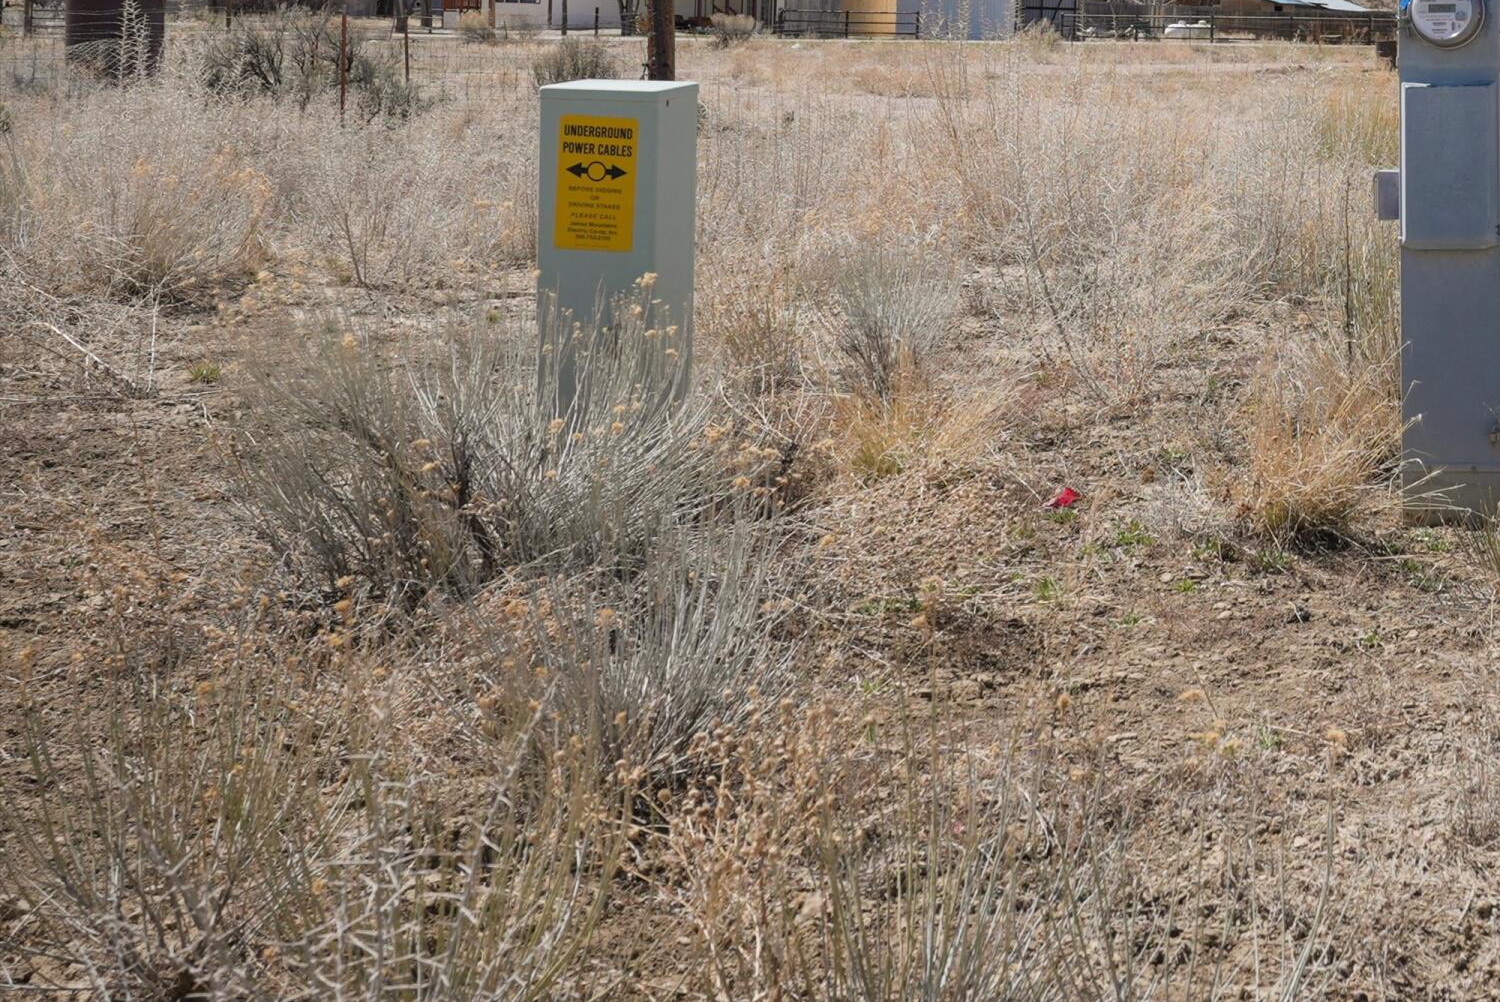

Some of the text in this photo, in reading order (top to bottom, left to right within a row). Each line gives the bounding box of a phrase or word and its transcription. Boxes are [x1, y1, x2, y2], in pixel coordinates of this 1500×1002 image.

[564, 124, 633, 139] UNDERGROUND
[563, 142, 632, 157] POWER CABLES
